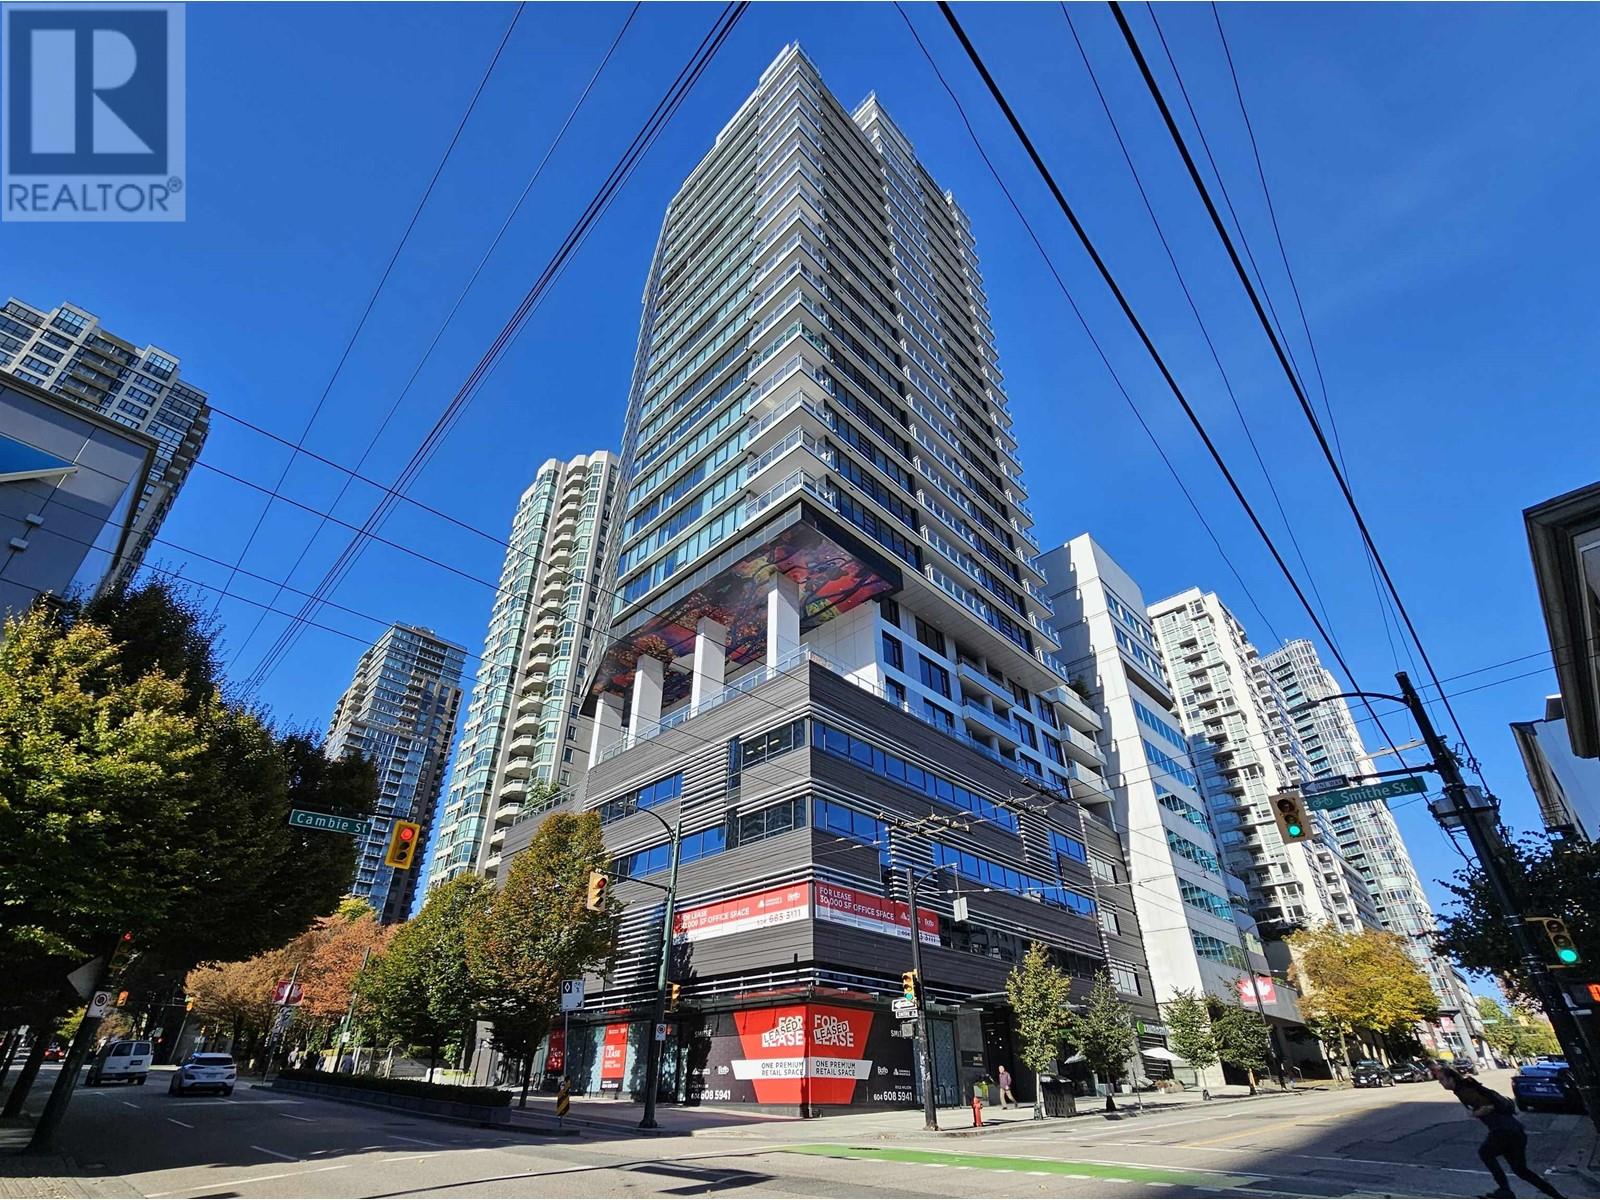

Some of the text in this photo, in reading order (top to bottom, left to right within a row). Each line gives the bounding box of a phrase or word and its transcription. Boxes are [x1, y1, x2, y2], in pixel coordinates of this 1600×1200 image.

[1340, 783, 1414, 803] Smithe St.
[296, 813, 367, 834] Cambie St
[819, 886, 852, 901] FOR LEASE
[707, 912, 729, 923] OFFICE
[729, 907, 750, 918] SPACE
[843, 901, 852, 910] SF
[853, 903, 875, 916] OFFICE
[875, 910, 895, 920] SPACE
[778, 1015, 803, 1031] FOR
[814, 1014, 838, 1028] FOR
[763, 1020, 798, 1044] LEASED
[814, 1030, 854, 1047] EASE
[815, 1022, 848, 1040] LEASED
[775, 1061, 804, 1069] PREMIUM
[816, 1060, 856, 1069] ONE PREMIUM
[816, 1067, 856, 1077] RETAIL SPACE
[761, 1068, 804, 1077] RETAIL SPACE
[700, 1089, 713, 1100] 608
[714, 1089, 731, 1100] 5941
[873, 1091, 913, 1102] 604 608 5941
